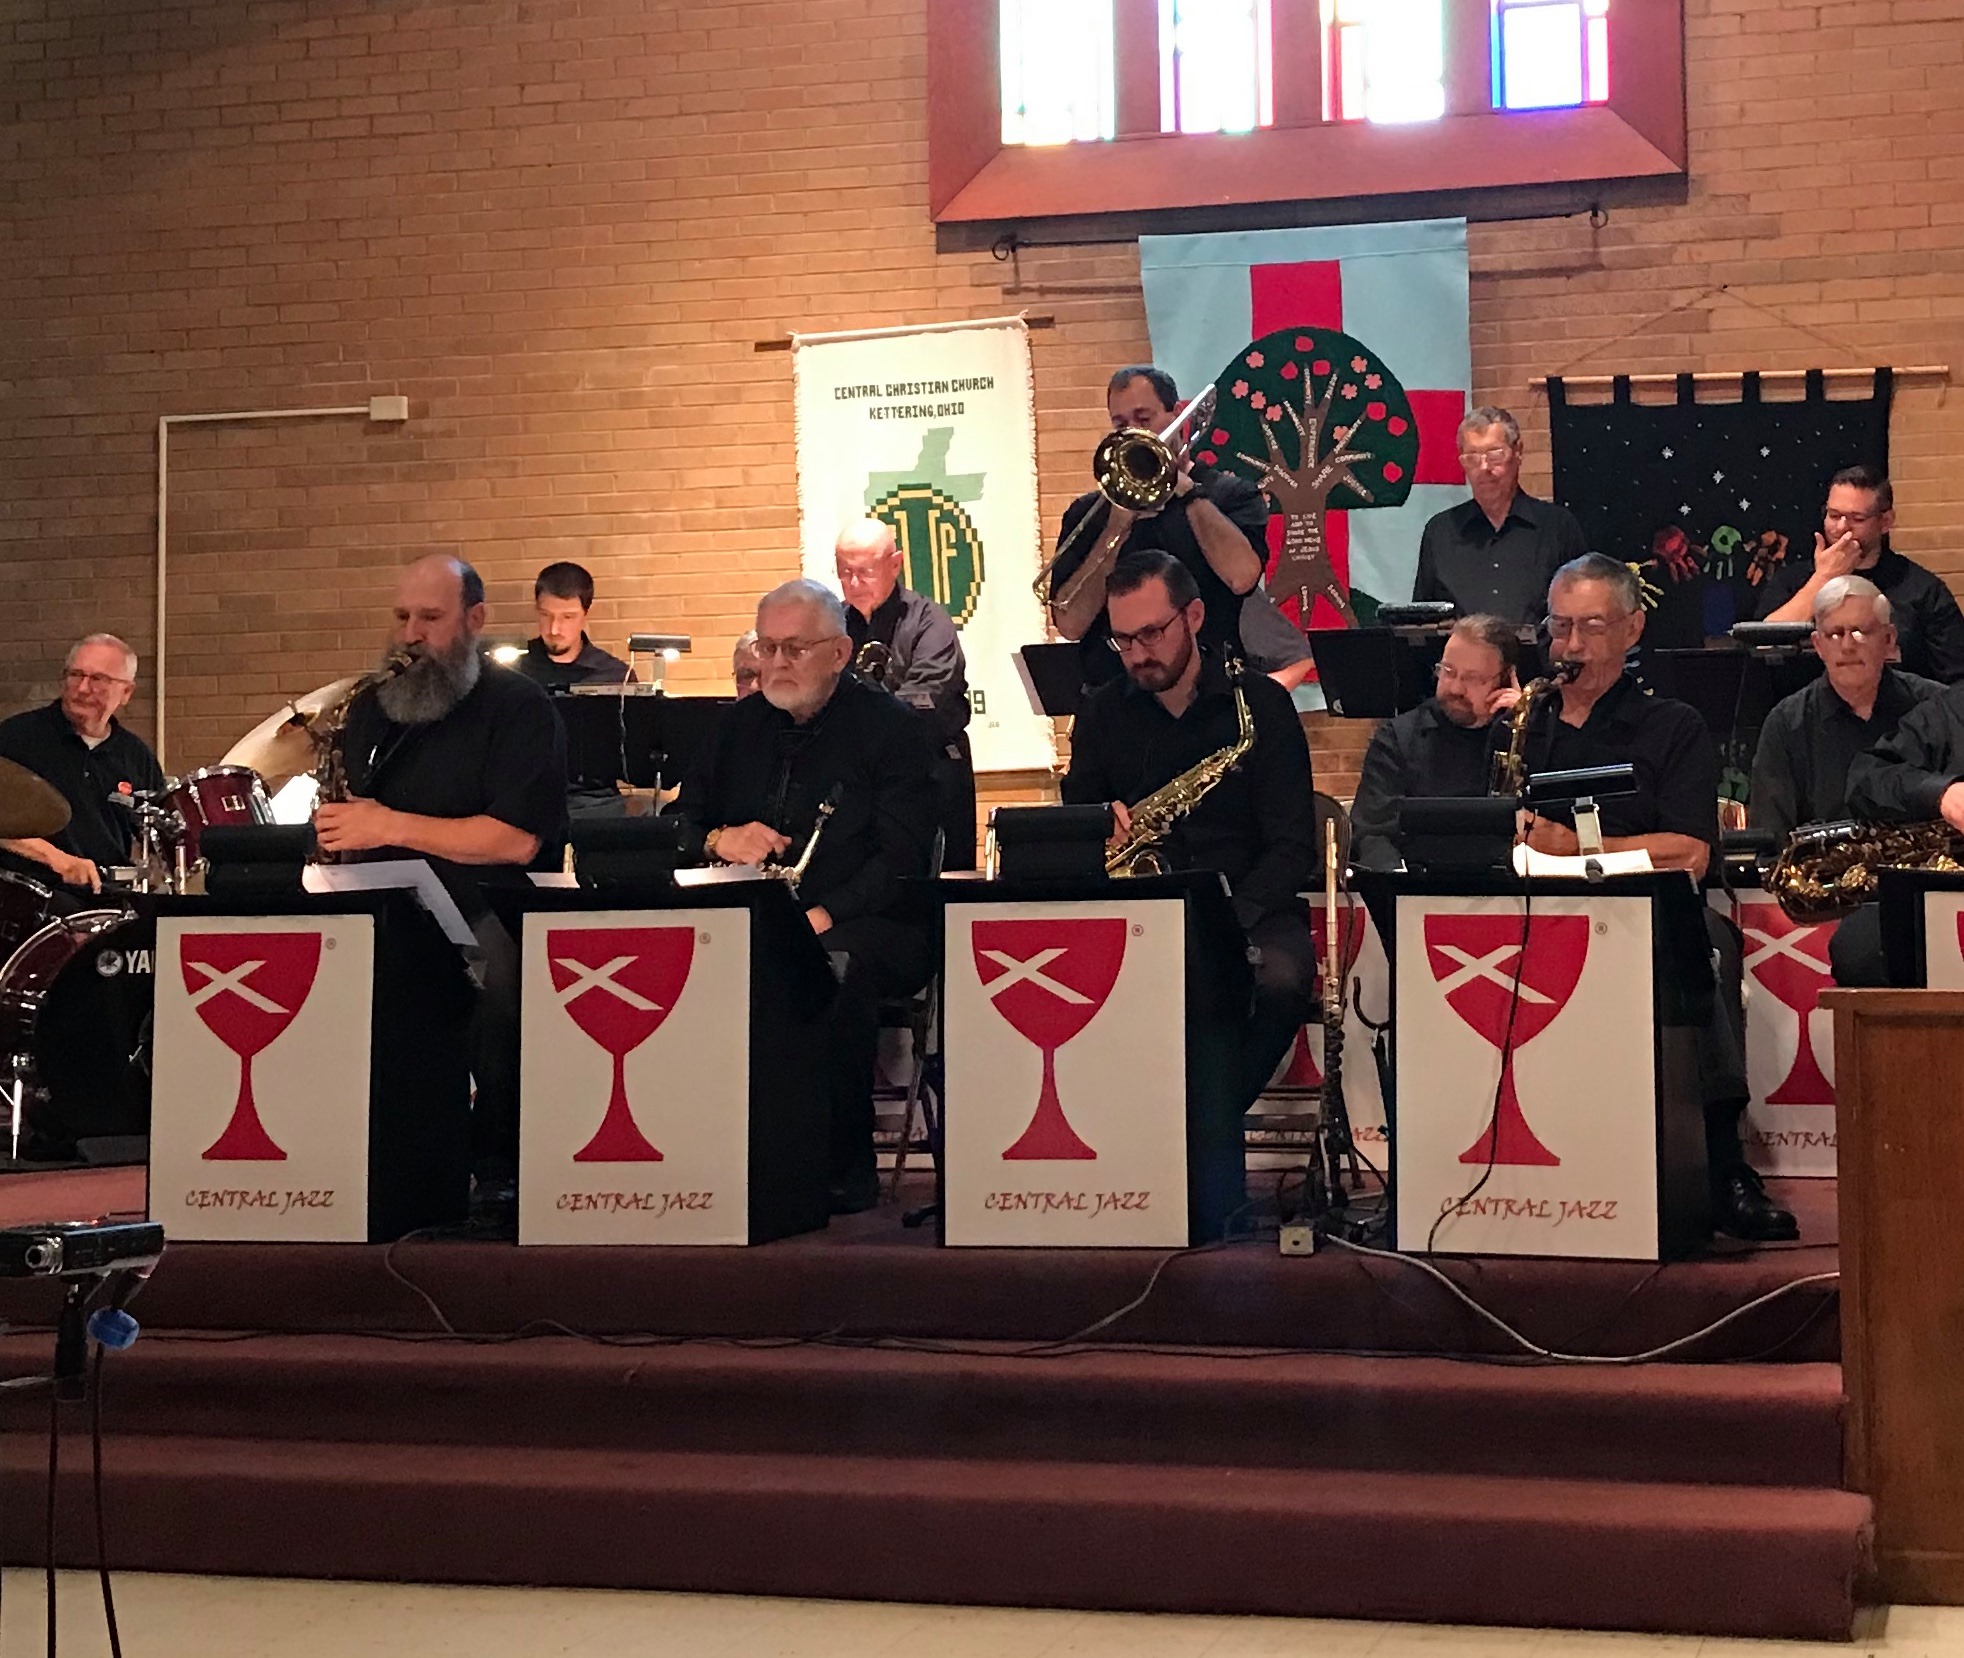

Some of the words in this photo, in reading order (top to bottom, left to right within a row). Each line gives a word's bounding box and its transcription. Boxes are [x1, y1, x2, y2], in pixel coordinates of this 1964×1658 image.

[834, 384, 883, 400] CENTRAL
[885, 380, 949, 397] CHRISTIAN
[951, 376, 994, 393] CHURCH
[1308, 417, 1318, 469] EXPERIENCE
[1311, 464, 1334, 490] SHARE
[125, 949, 155, 974] YA
[185, 1189, 279, 1211] CENTRAL
[279, 1190, 335, 1216] JAZZ
[556, 1192, 655, 1214] CENTRAL
[655, 1192, 714, 1219] JAZZ
[984, 1191, 1088, 1214] CENTRAL
[1088, 1191, 1151, 1219] JAZZ
[1440, 1196, 1552, 1220] CENTRAL
[1552, 1200, 1618, 1228] JAZZ
